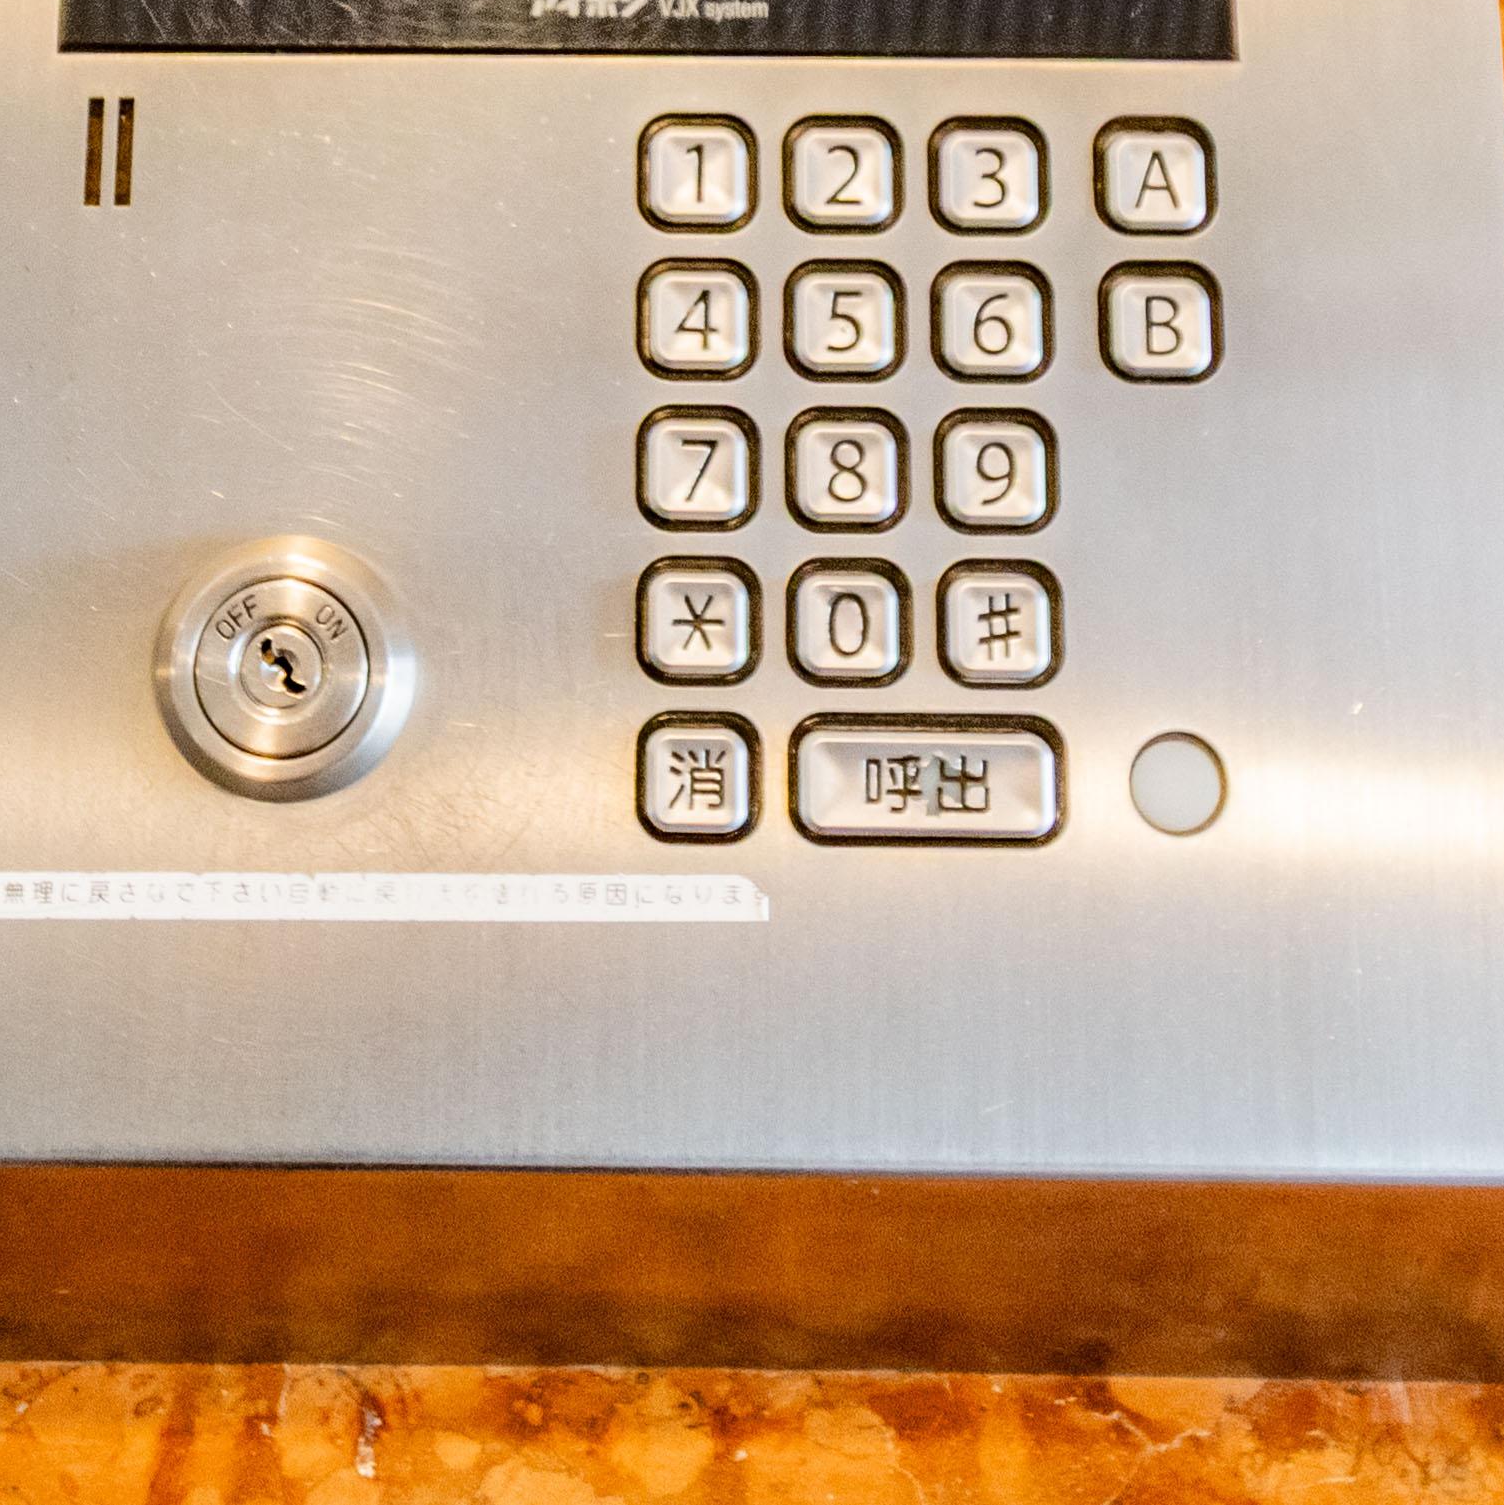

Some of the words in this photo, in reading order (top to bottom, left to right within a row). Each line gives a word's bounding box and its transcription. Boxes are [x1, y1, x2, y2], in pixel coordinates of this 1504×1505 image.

[705, 1, 770, 23] system
[683, 143, 707, 204] 1
[825, 144, 864, 206] 2
[972, 147, 1008, 210] 3
[1134, 149, 1181, 211] A
[675, 288, 719, 351] 4
[826, 290, 864, 353] 5
[971, 293, 1013, 356] 6
[1144, 296, 1184, 356] B
[680, 438, 720, 504] 7
[825, 438, 868, 504] 8
[974, 441, 1016, 507] 9
[214, 593, 259, 643] OFF
[314, 603, 349, 642] ON
[827, 591, 871, 658] 0
[667, 748, 728, 811] 消
[864, 754, 991, 814] 呼出
